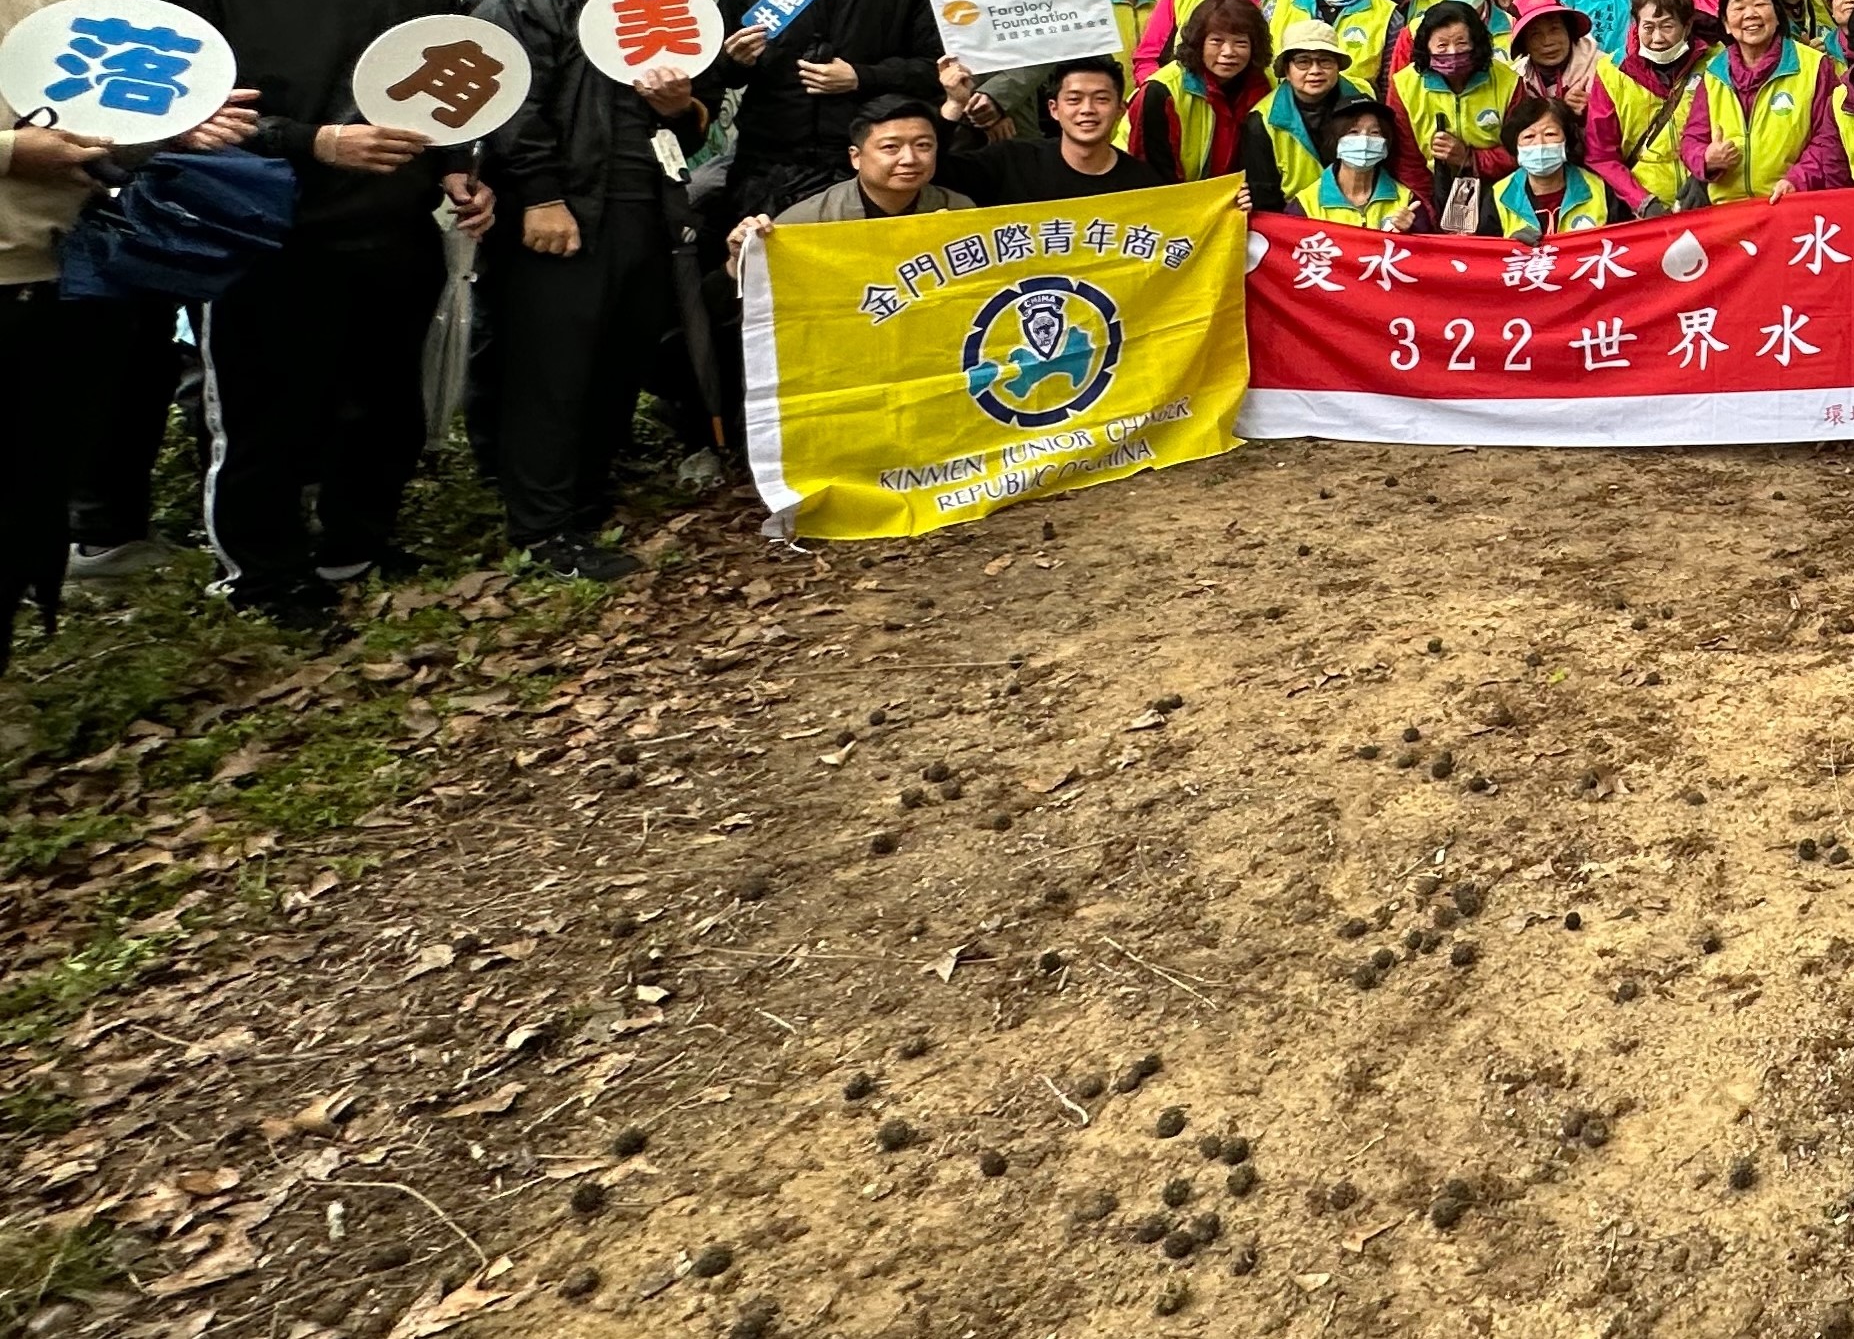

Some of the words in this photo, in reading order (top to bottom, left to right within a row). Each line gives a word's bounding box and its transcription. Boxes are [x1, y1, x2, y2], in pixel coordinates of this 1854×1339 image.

[987, 0, 1053, 18] Farglory
[991, 9, 1079, 31] Foundation
[44, 17, 203, 117] 落
[385, 39, 504, 128] 角
[858, 217, 1196, 326] 金門國際青年商會
[880, 455, 985, 491] KINMEN
[1001, 429, 1093, 469] JUNIOR
